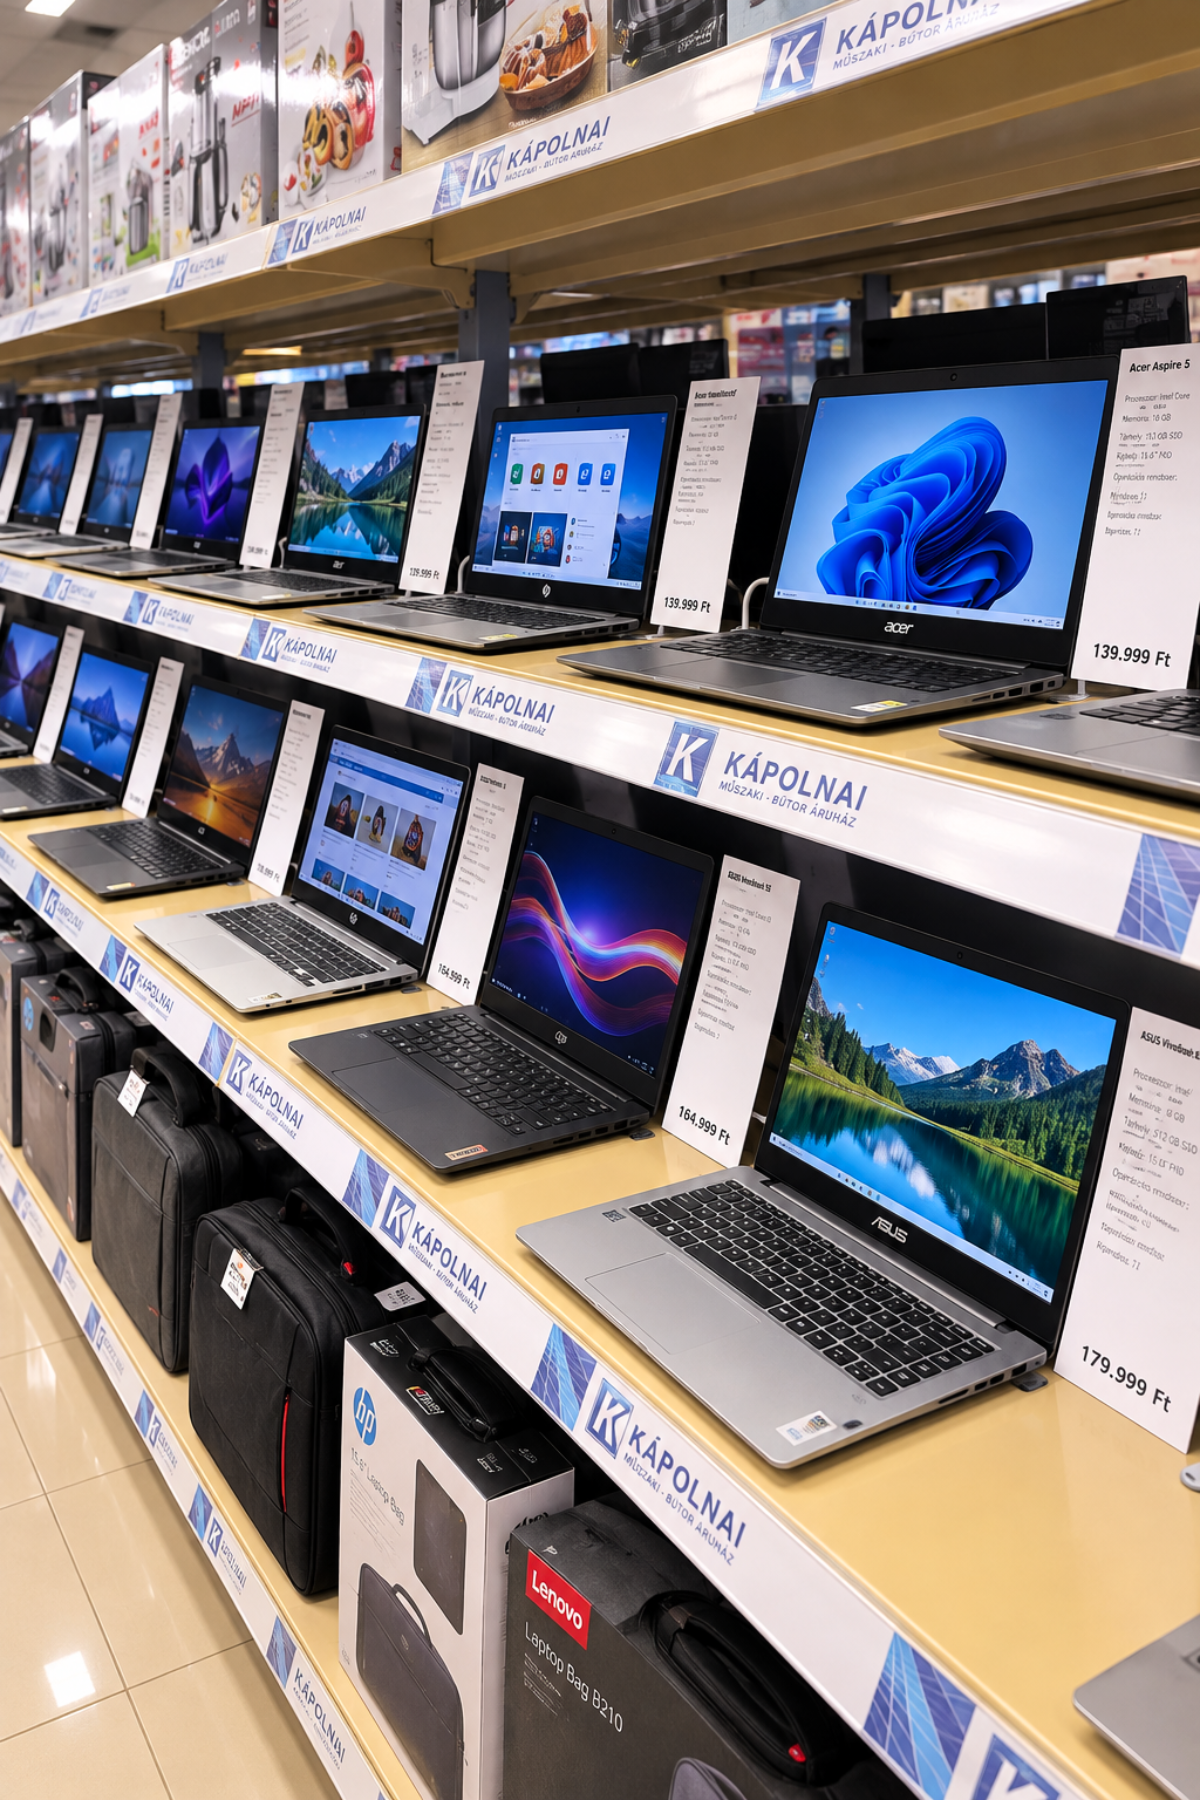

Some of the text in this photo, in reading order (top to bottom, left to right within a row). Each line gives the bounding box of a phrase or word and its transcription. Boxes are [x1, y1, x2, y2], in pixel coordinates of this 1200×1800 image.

[506, 115, 612, 171] KÁPOLNAI
[1129, 358, 1190, 374] Acer Aspire 5
[664, 596, 711, 613] 139.999 Ft
[884, 621, 914, 635] acer
[1093, 643, 1171, 667] 139.999 Ft
[471, 685, 556, 724] KÁPOLNAI
[724, 751, 868, 811] KÁPOLNAI
[809, 802, 857, 828] ÁRUHÁZ
[1140, 1030, 1161, 1046] ASUS
[248, 1073, 304, 1130] KÁPOLNAI
[678, 1105, 731, 1146] 164.999 Ft
[871, 1216, 909, 1244] ASUS
[411, 1221, 487, 1302] KÁPOLNAI
[1082, 1345, 1173, 1413] 179.999 Ft
[354, 1387, 376, 1445] hp
[628, 1424, 746, 1549] KÁPOLNAI
[531, 1570, 583, 1630] Lenovo
[525, 1621, 565, 1675] Laptop
[566, 1663, 590, 1703] Bag
[592, 1688, 624, 1733] B210
